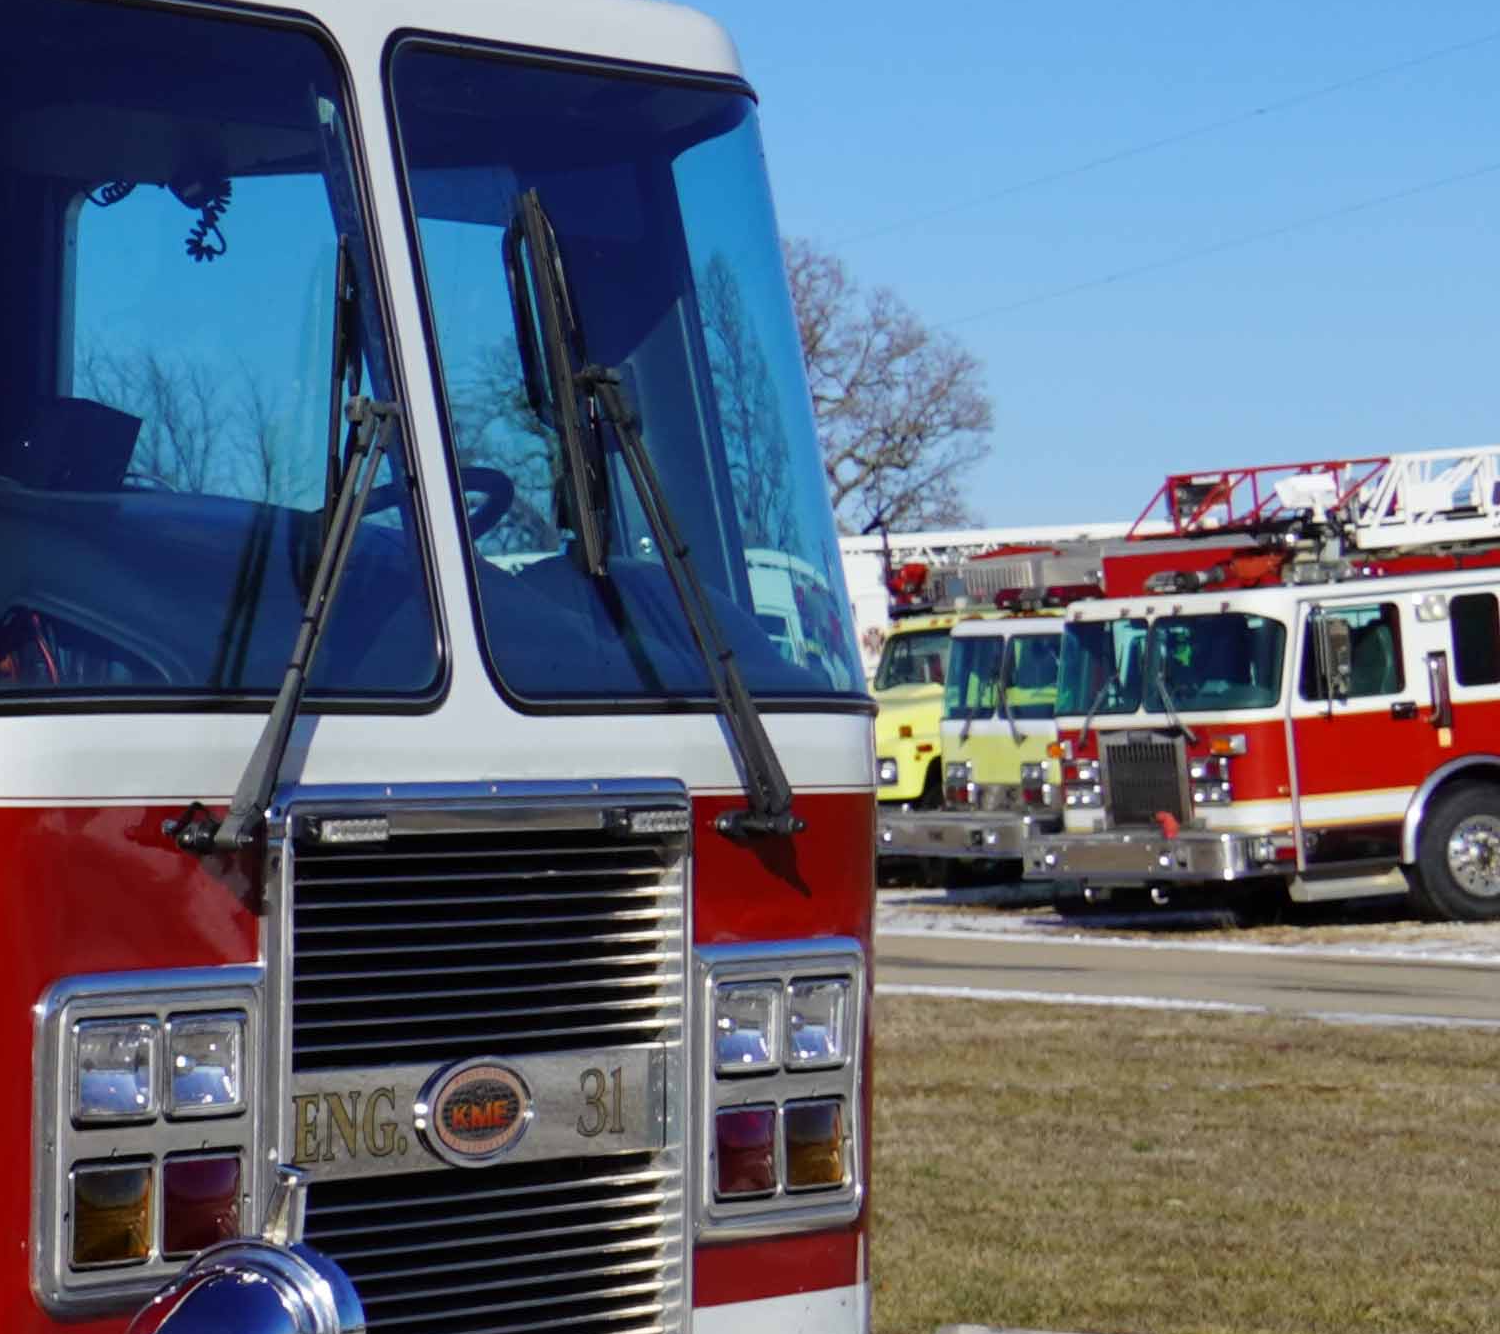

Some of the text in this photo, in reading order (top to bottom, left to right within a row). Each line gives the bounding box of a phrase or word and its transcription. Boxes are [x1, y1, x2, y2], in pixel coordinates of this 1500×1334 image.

[291, 1066, 626, 1164] ENG. 31
[451, 1099, 511, 1132] KME
